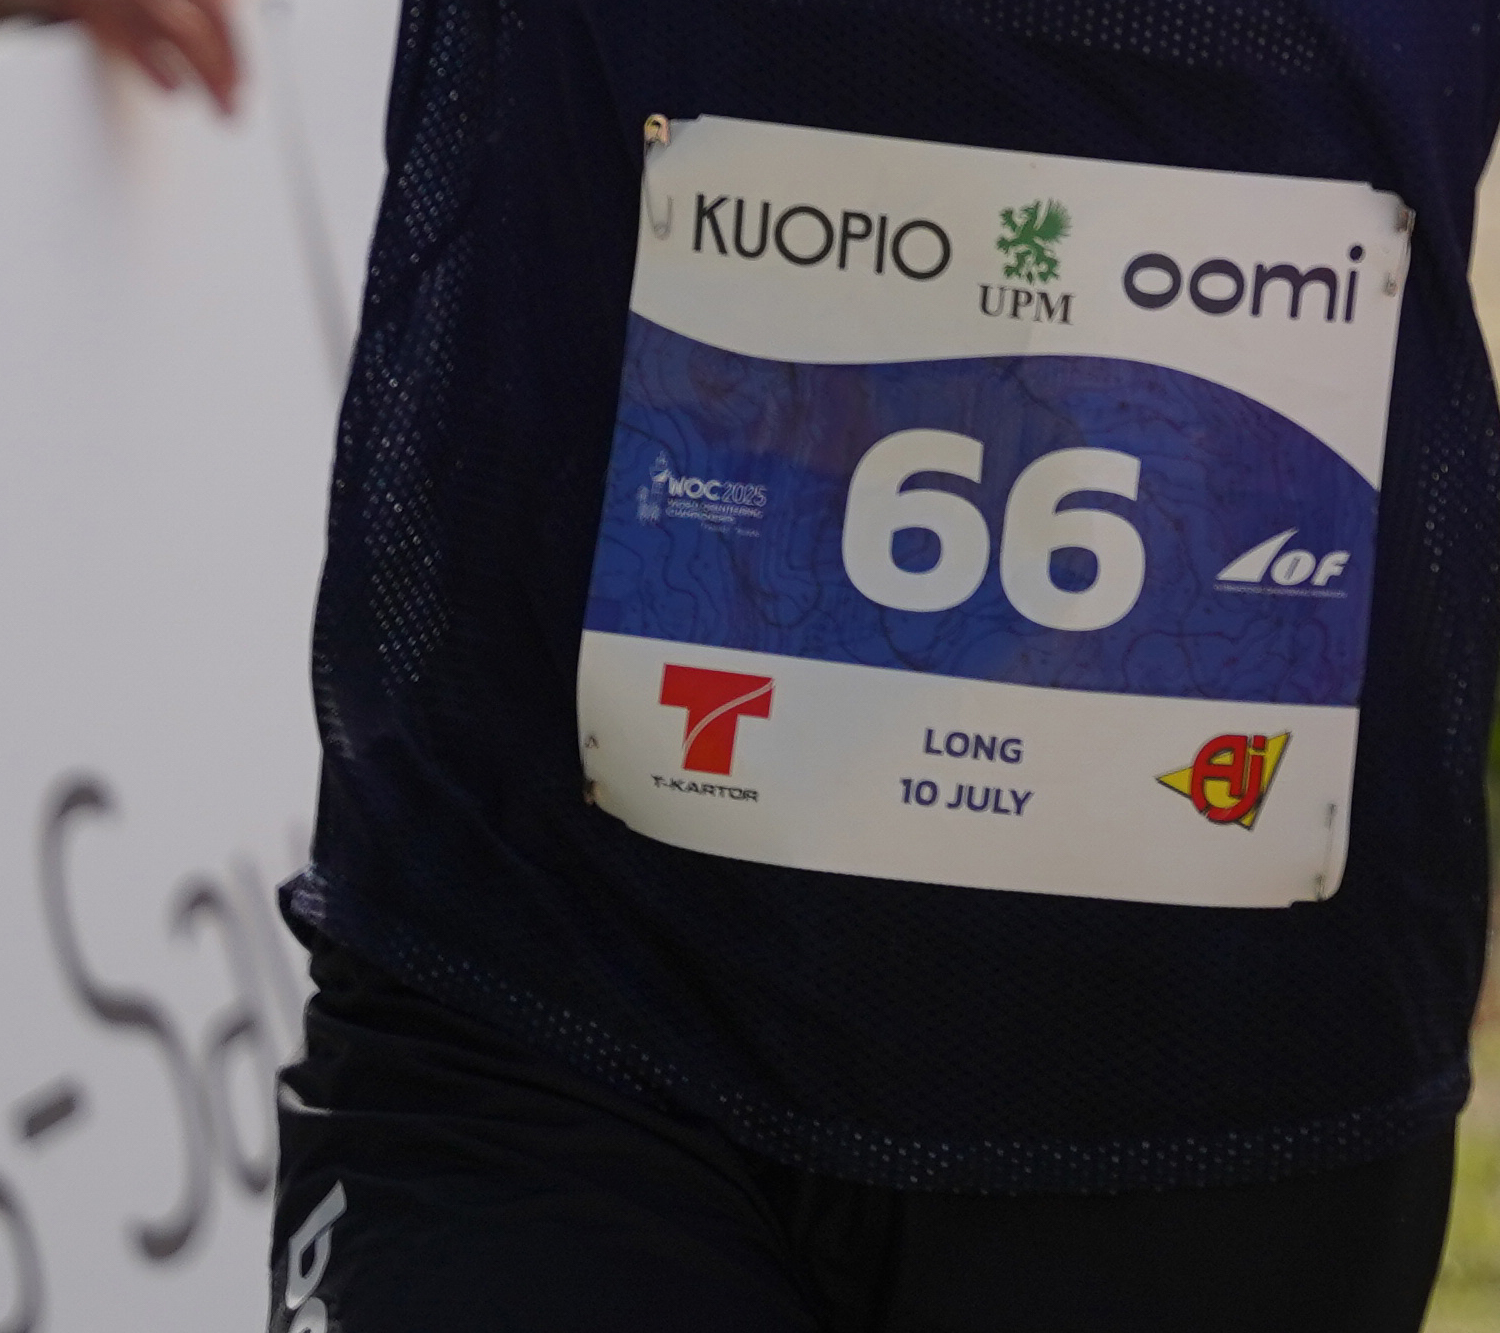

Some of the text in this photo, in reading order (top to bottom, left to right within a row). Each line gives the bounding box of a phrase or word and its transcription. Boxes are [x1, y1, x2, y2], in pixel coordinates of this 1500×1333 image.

[692, 193, 952, 281] KUOPIO
[978, 283, 1075, 326] UPM
[1124, 245, 1364, 323] oomi
[842, 427, 1146, 632] 66
[924, 727, 1024, 763] LONG
[651, 774, 759, 802] T-KARTOR
[901, 778, 1035, 816] 10 JULY
